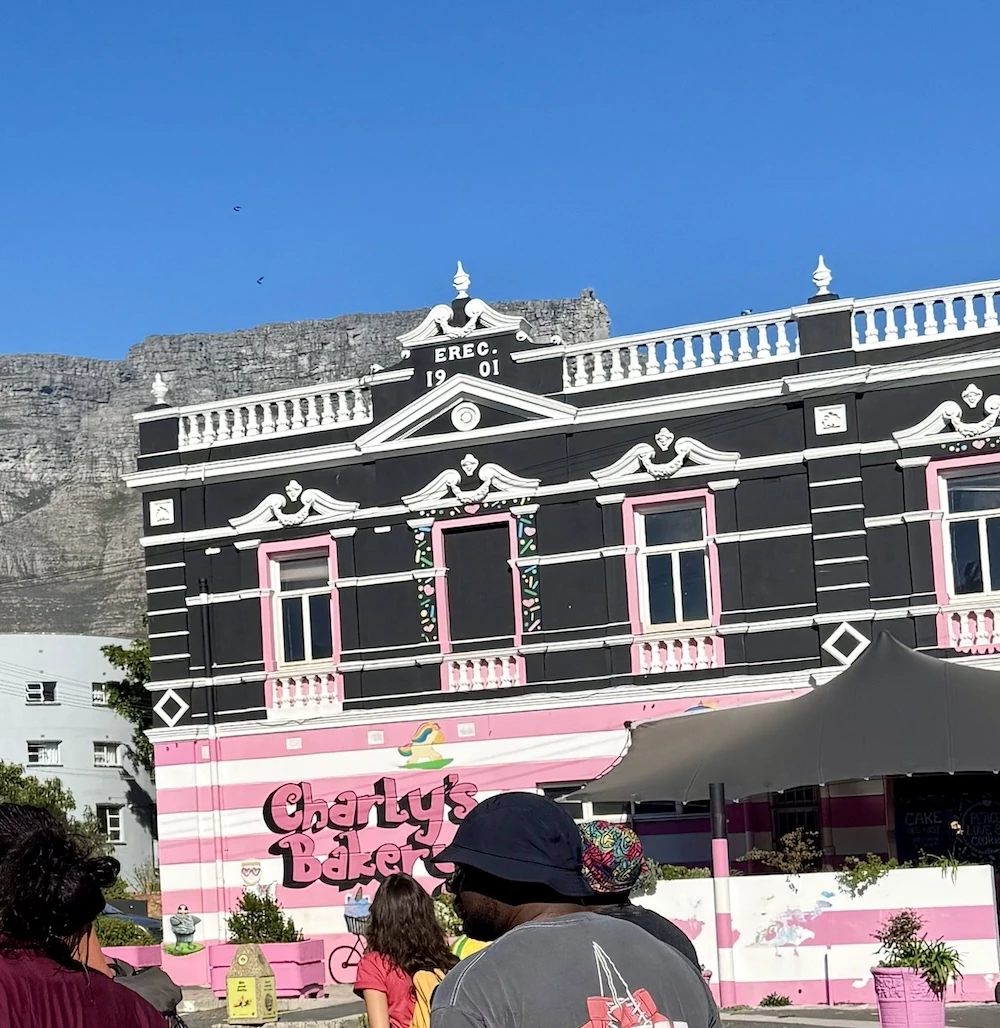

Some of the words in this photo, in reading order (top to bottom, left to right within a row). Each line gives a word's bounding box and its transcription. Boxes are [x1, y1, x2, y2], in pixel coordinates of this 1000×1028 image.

[434, 341, 498, 363] EREC.
[426, 369, 447, 387] 19
[479, 359, 499, 378] 01
[263, 774, 478, 846] Charly's
[905, 811, 942, 825] CAKE
